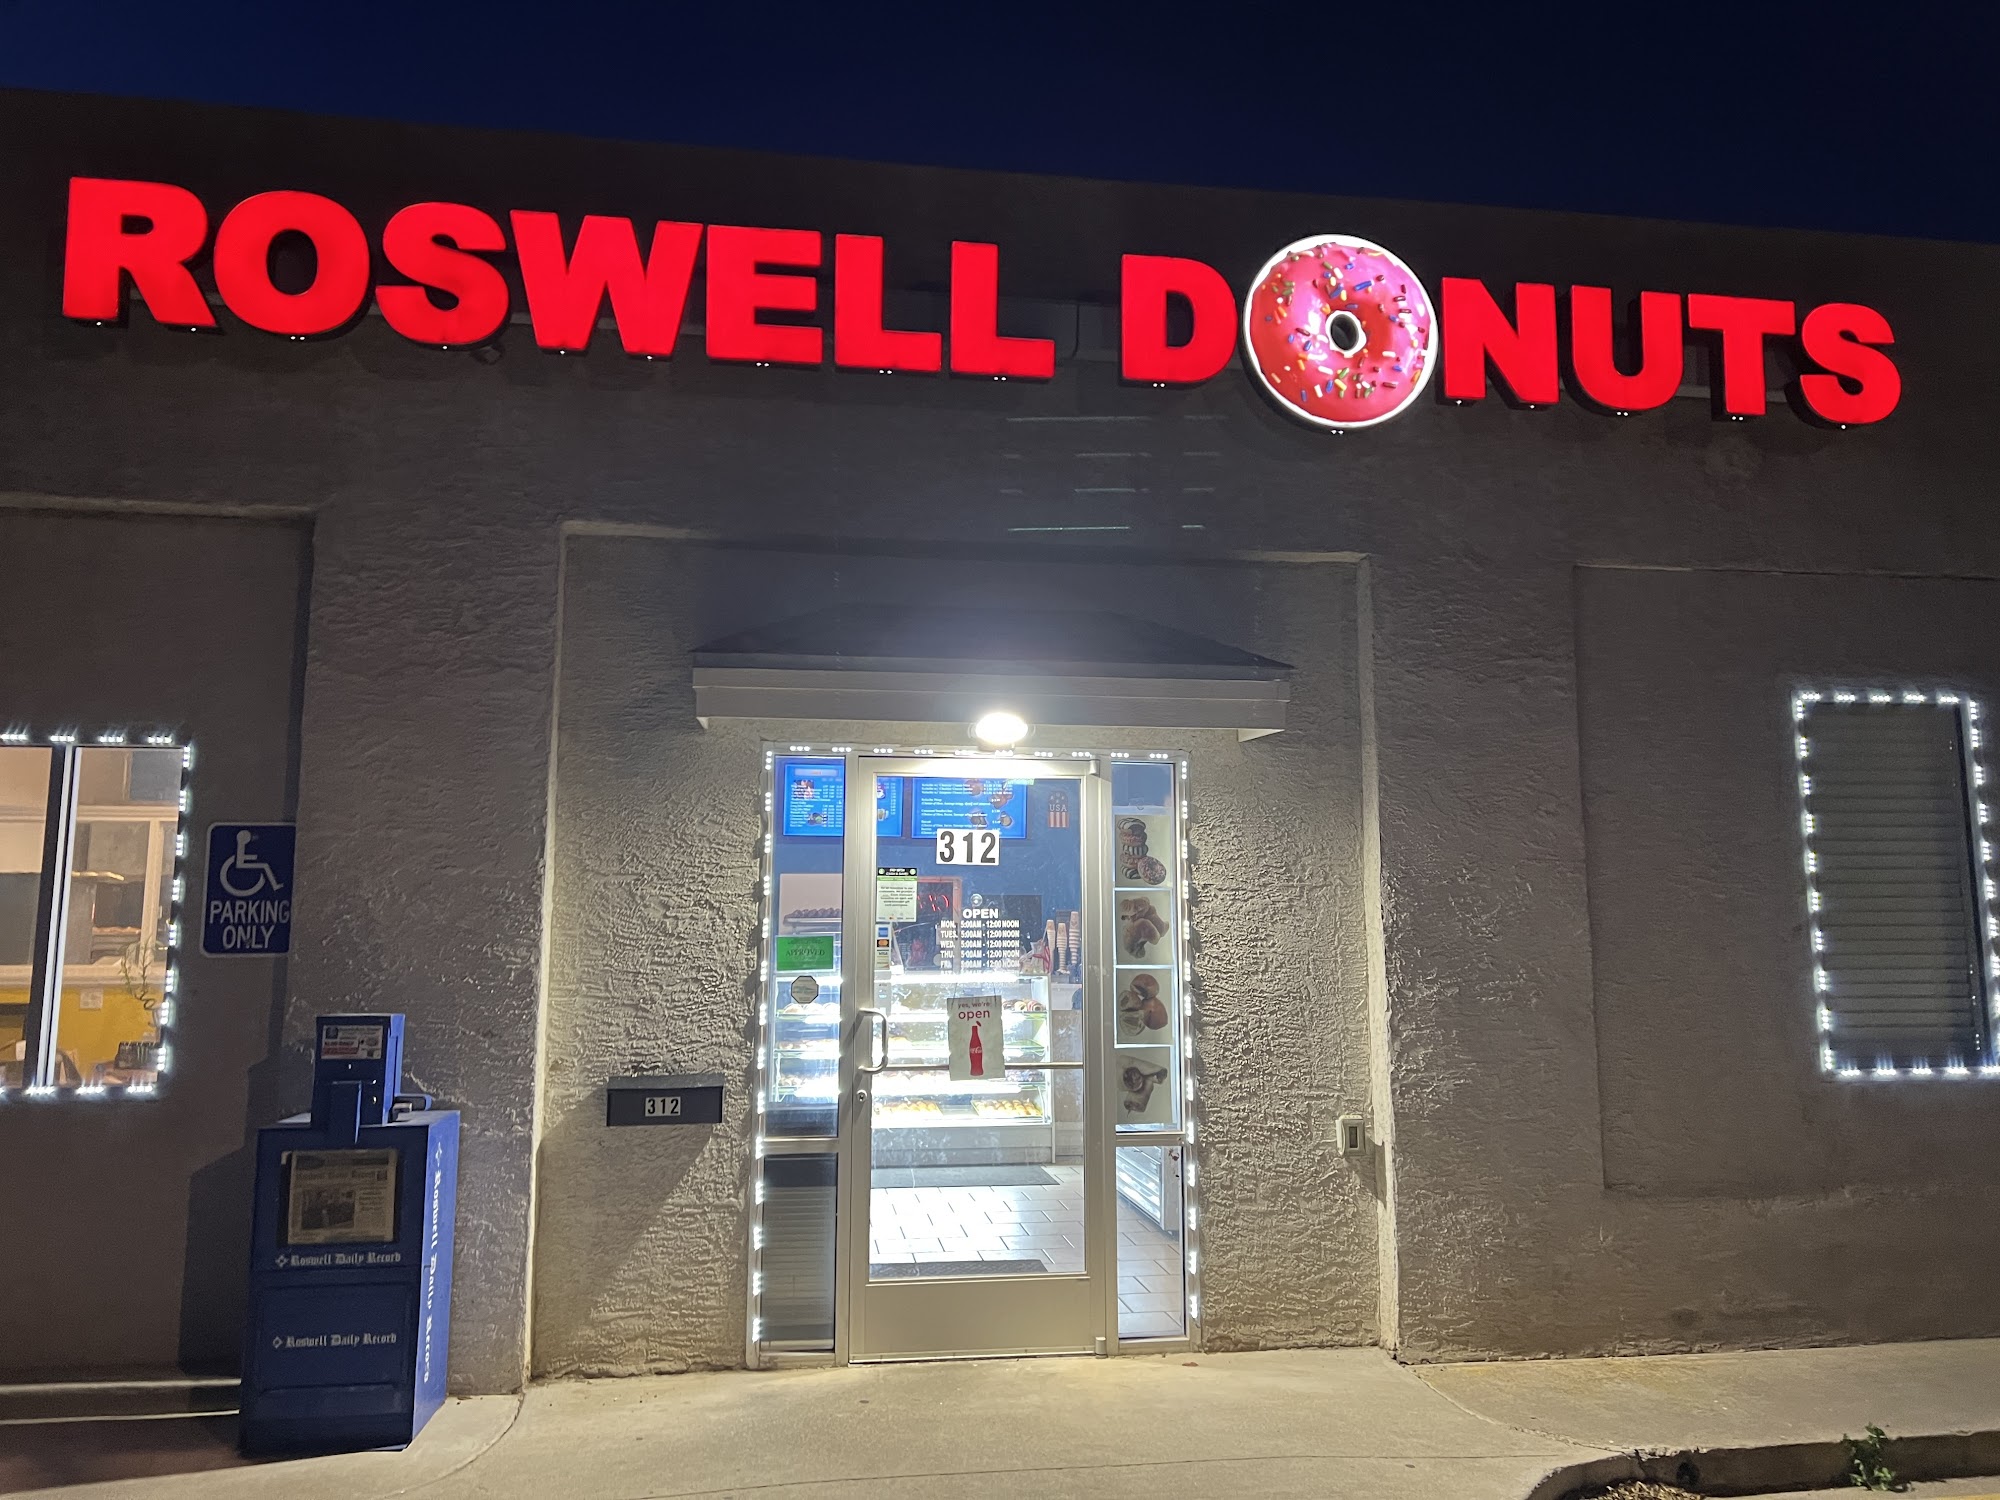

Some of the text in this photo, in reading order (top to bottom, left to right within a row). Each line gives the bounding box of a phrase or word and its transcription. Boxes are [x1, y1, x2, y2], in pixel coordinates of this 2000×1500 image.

[62, 176, 1055, 378] ROSWELL
[1049, 803, 1068, 812] USA
[939, 830, 996, 863] 312
[209, 900, 290, 924] PARKING
[962, 908, 999, 919] OPEN
[940, 920, 957, 929] MON.
[1002, 920, 1019, 928] NOON
[222, 925, 275, 949] ONLY
[940, 930, 958, 939] TUES.
[1002, 930, 1019, 938] NOON
[940, 940, 955, 948] WED.
[1002, 940, 1019, 948] NOON
[940, 950, 954, 958] THU.
[1002, 950, 1019, 958] NOON
[958, 1010, 990, 1021] open
[647, 1098, 679, 1114] 312
[290, 1251, 401, 1266] Roswell Daily Record
[423, 1169, 442, 1383] Roswell Daily Record
[285, 1332, 397, 1348] Roswell Daily Record
